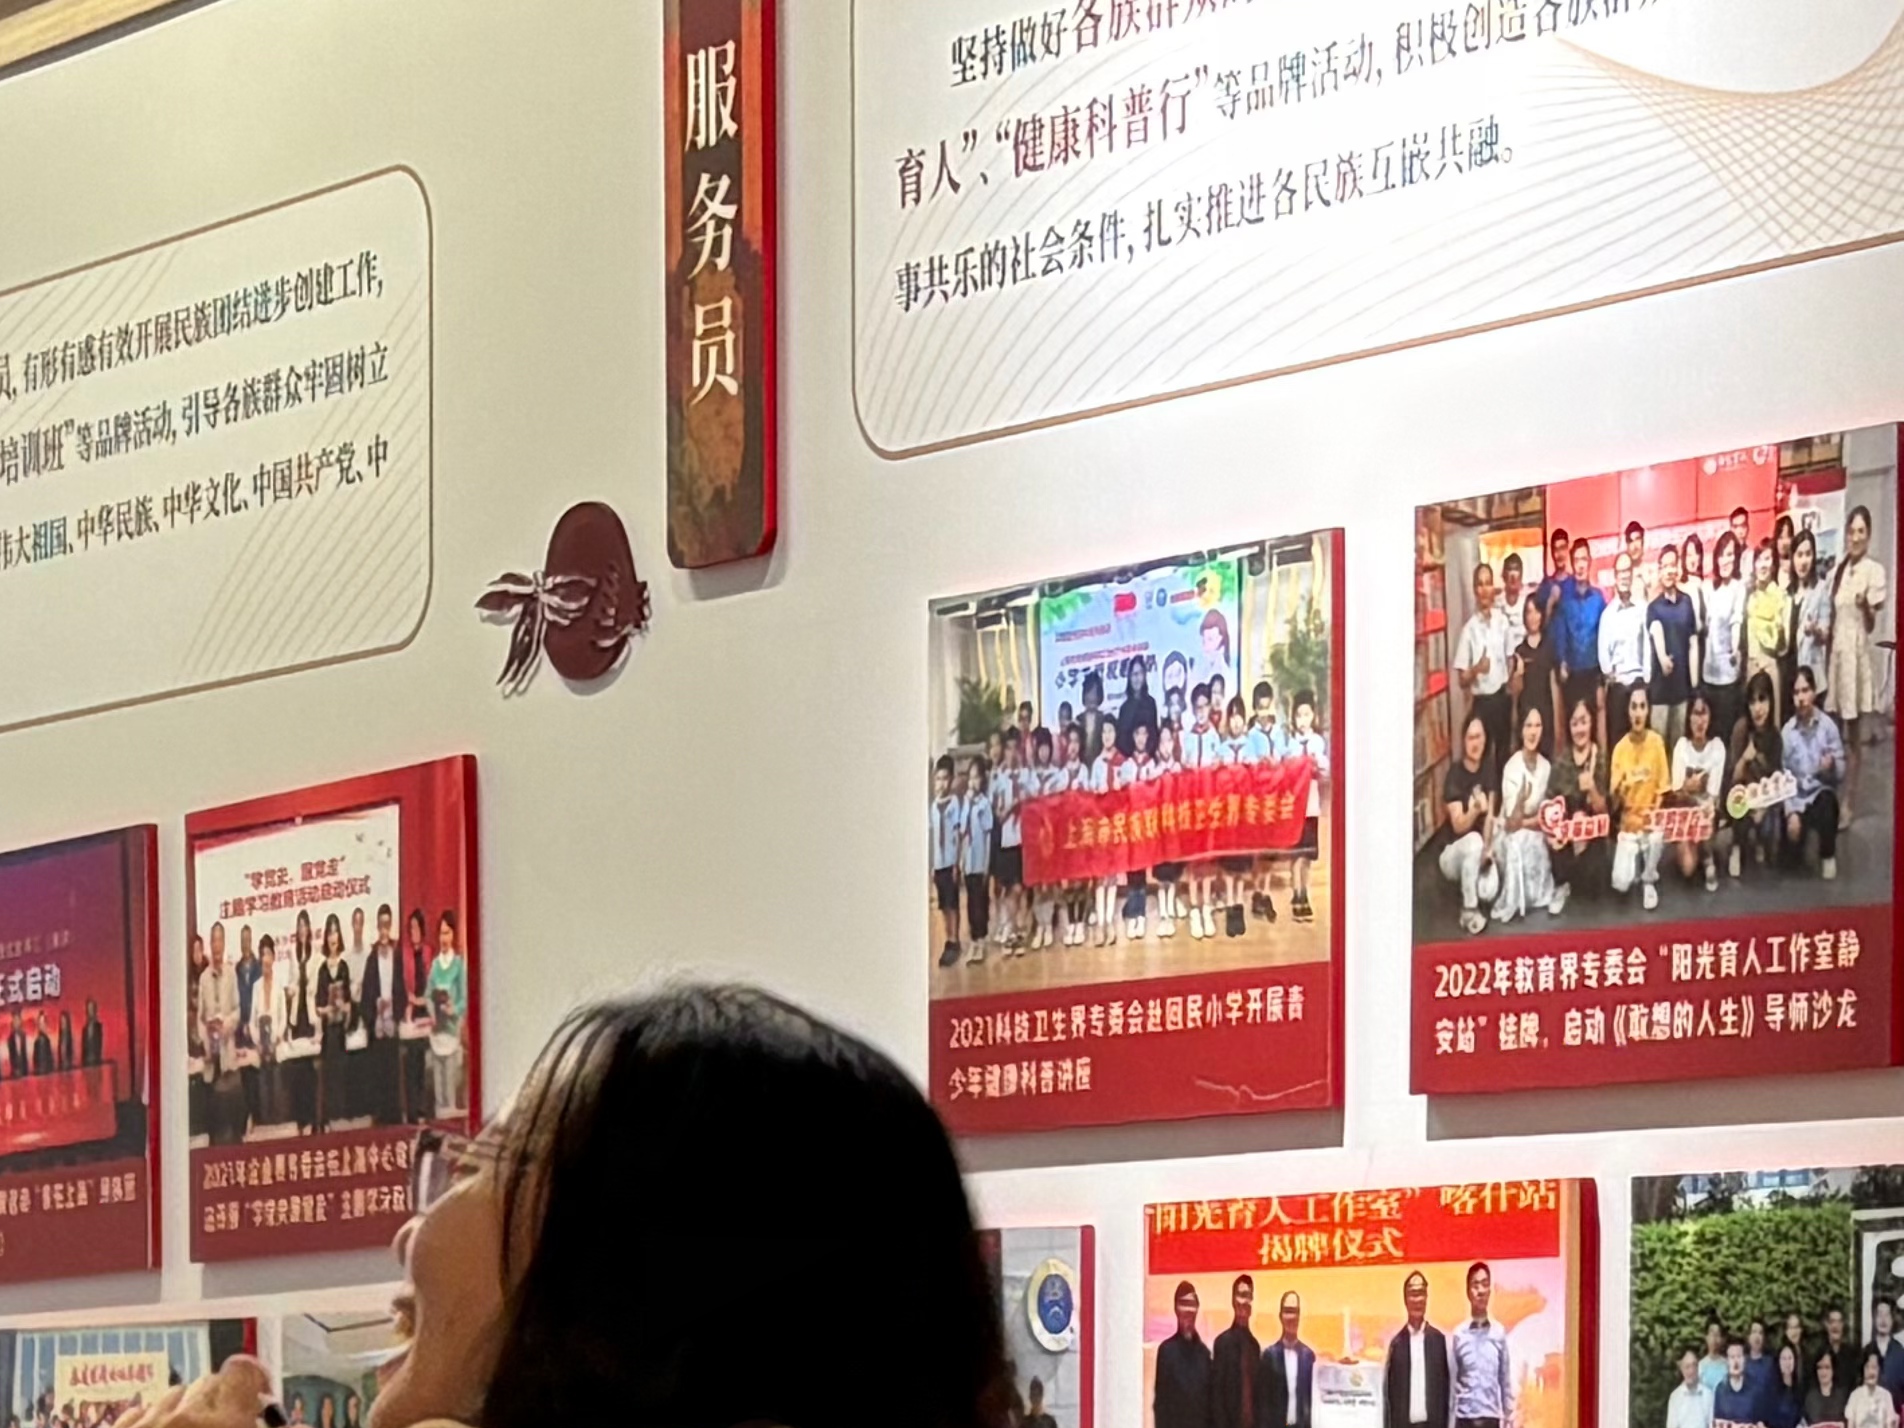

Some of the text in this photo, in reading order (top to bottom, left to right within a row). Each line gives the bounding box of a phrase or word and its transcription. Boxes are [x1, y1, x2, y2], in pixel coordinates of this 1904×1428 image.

[684, 39, 739, 407] 服务员
[1257, 1227, 1405, 1266] 揭牌仪式
